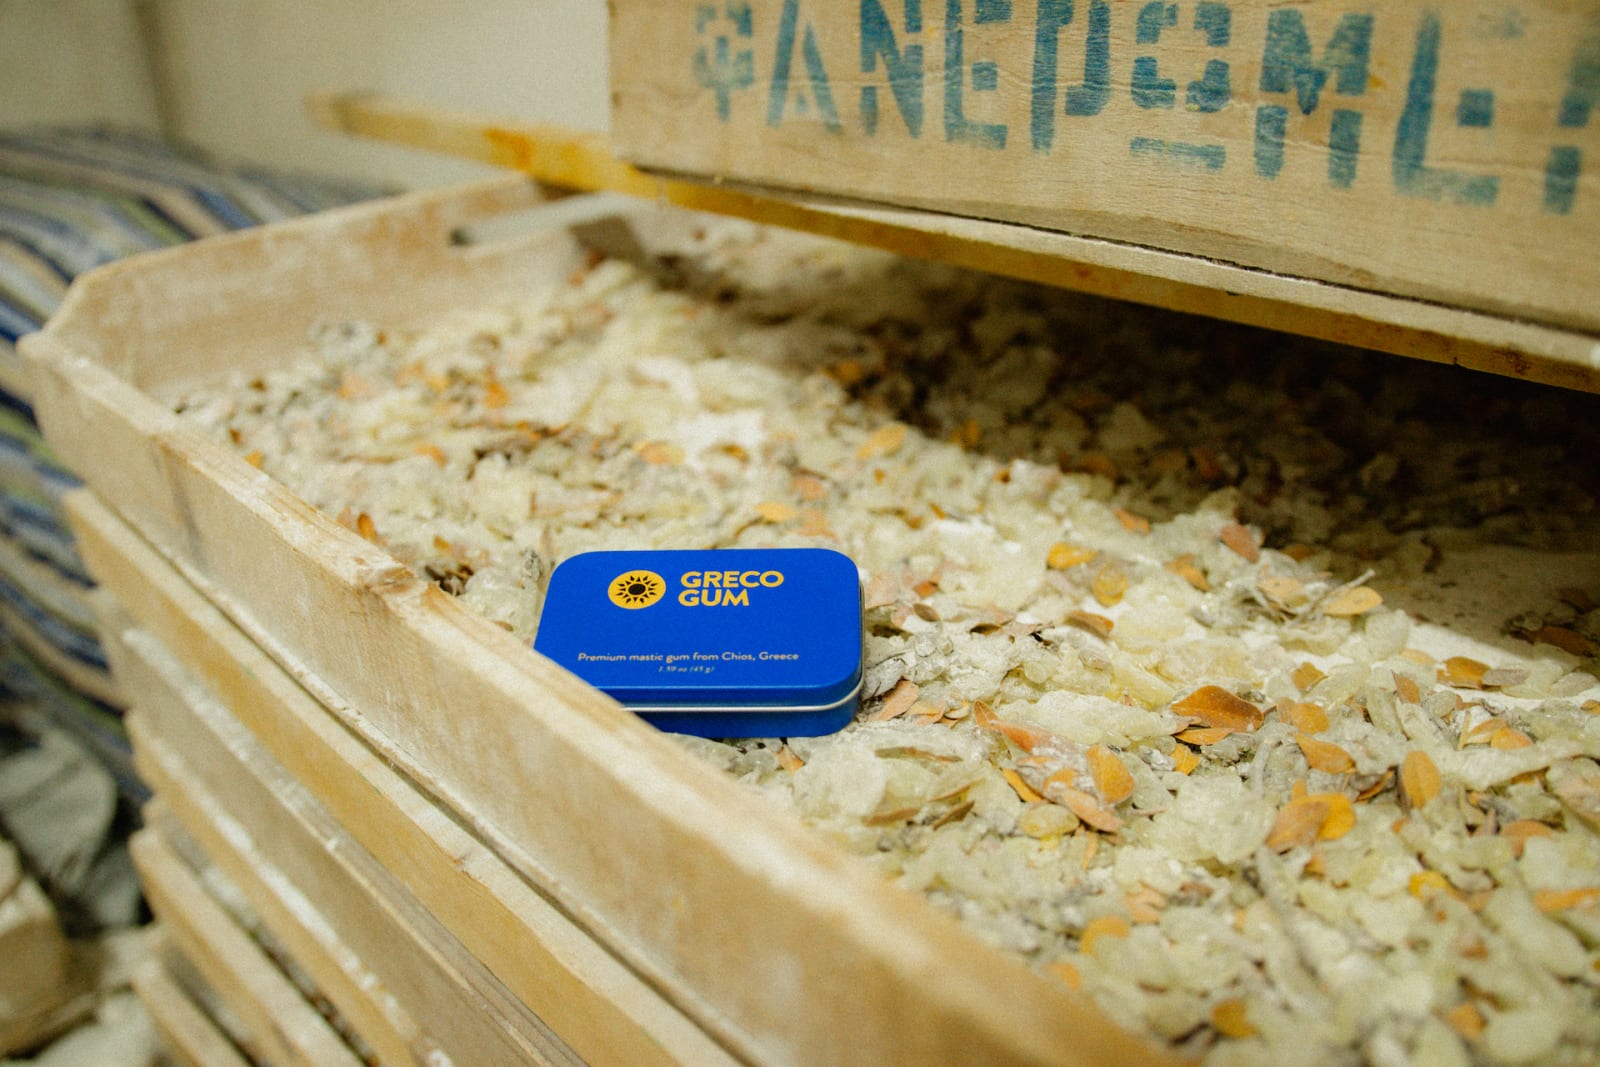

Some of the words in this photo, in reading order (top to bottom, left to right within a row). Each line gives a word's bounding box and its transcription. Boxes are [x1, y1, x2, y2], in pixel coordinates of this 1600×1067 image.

[680, 570, 785, 589] GRECO
[677, 588, 750, 607] GUM
[577, 652, 627, 662] Premium
[628, 652, 664, 662] mastic
[665, 654, 690, 666] gum
[692, 652, 719, 662] from
[721, 651, 756, 663] Chios,
[758, 651, 799, 662] Greece
